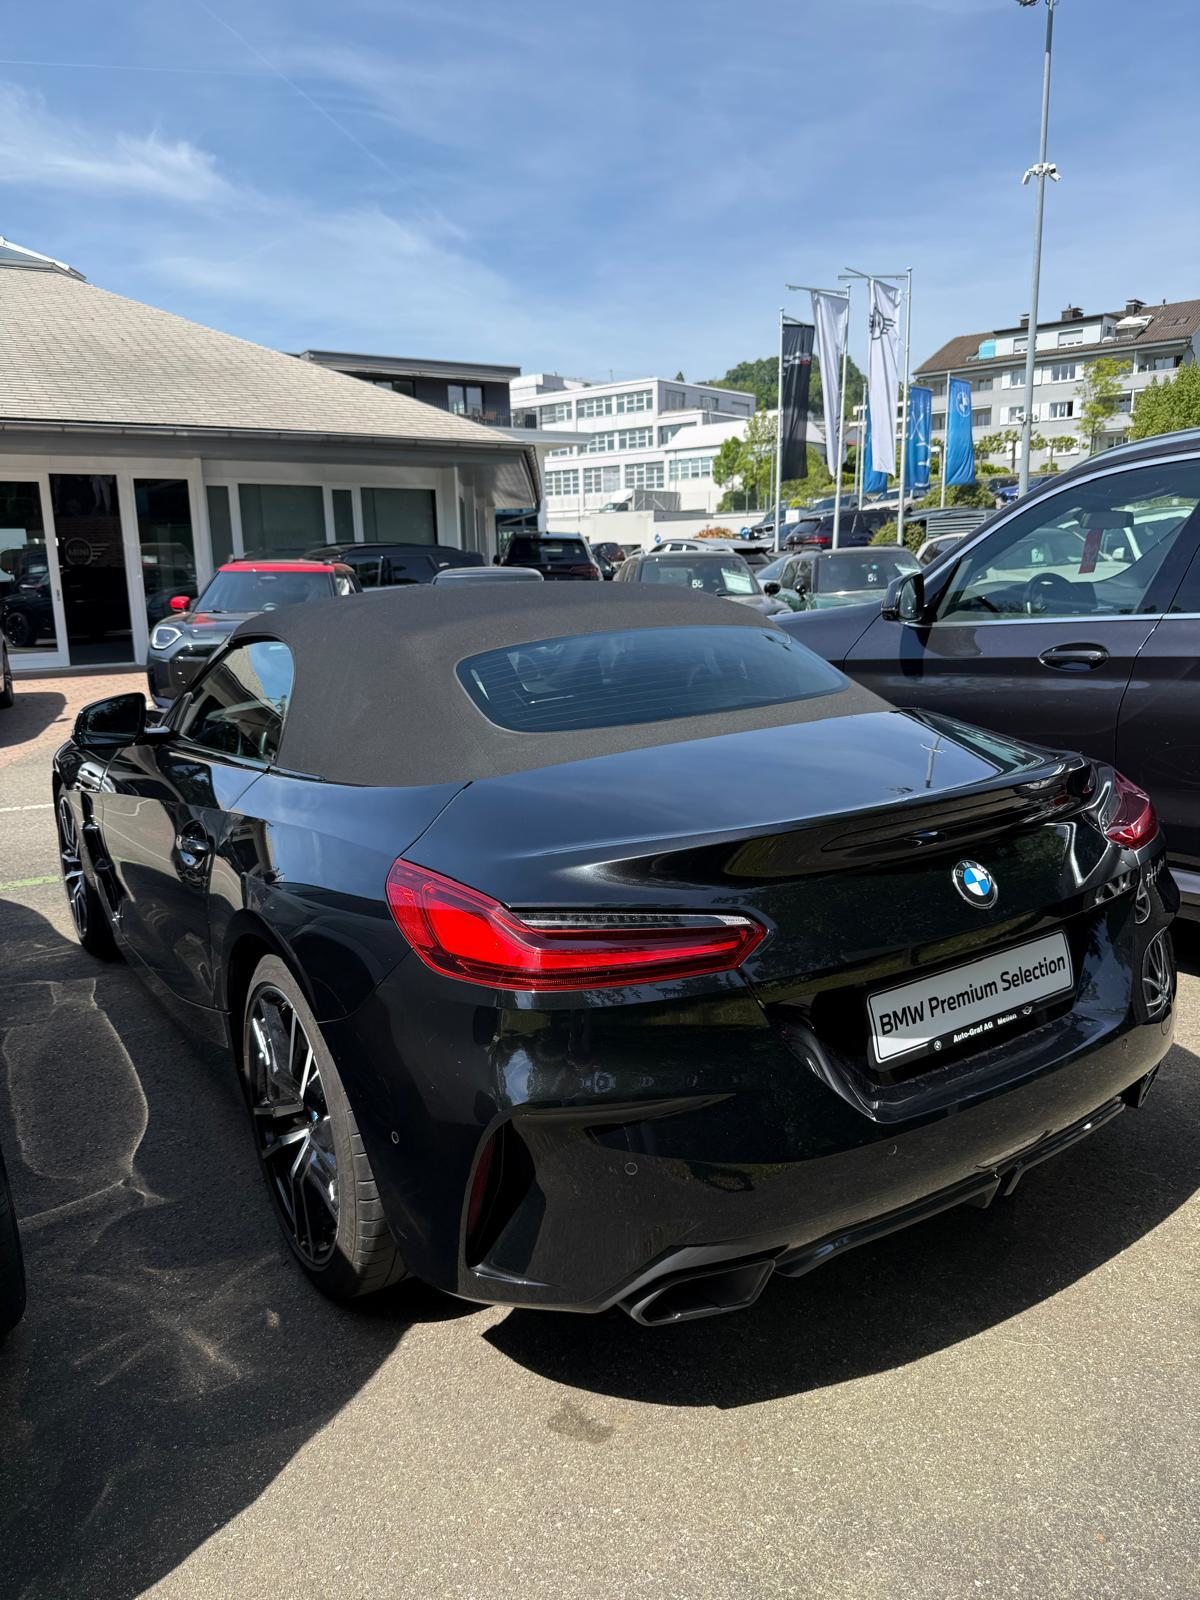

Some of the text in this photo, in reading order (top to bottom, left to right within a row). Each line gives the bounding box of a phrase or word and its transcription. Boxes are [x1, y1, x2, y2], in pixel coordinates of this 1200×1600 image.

[879, 955, 1066, 1035] BMW Premium Selection
[953, 1025, 983, 1044] Auto-Graf
[983, 1021, 994, 1031] AG
